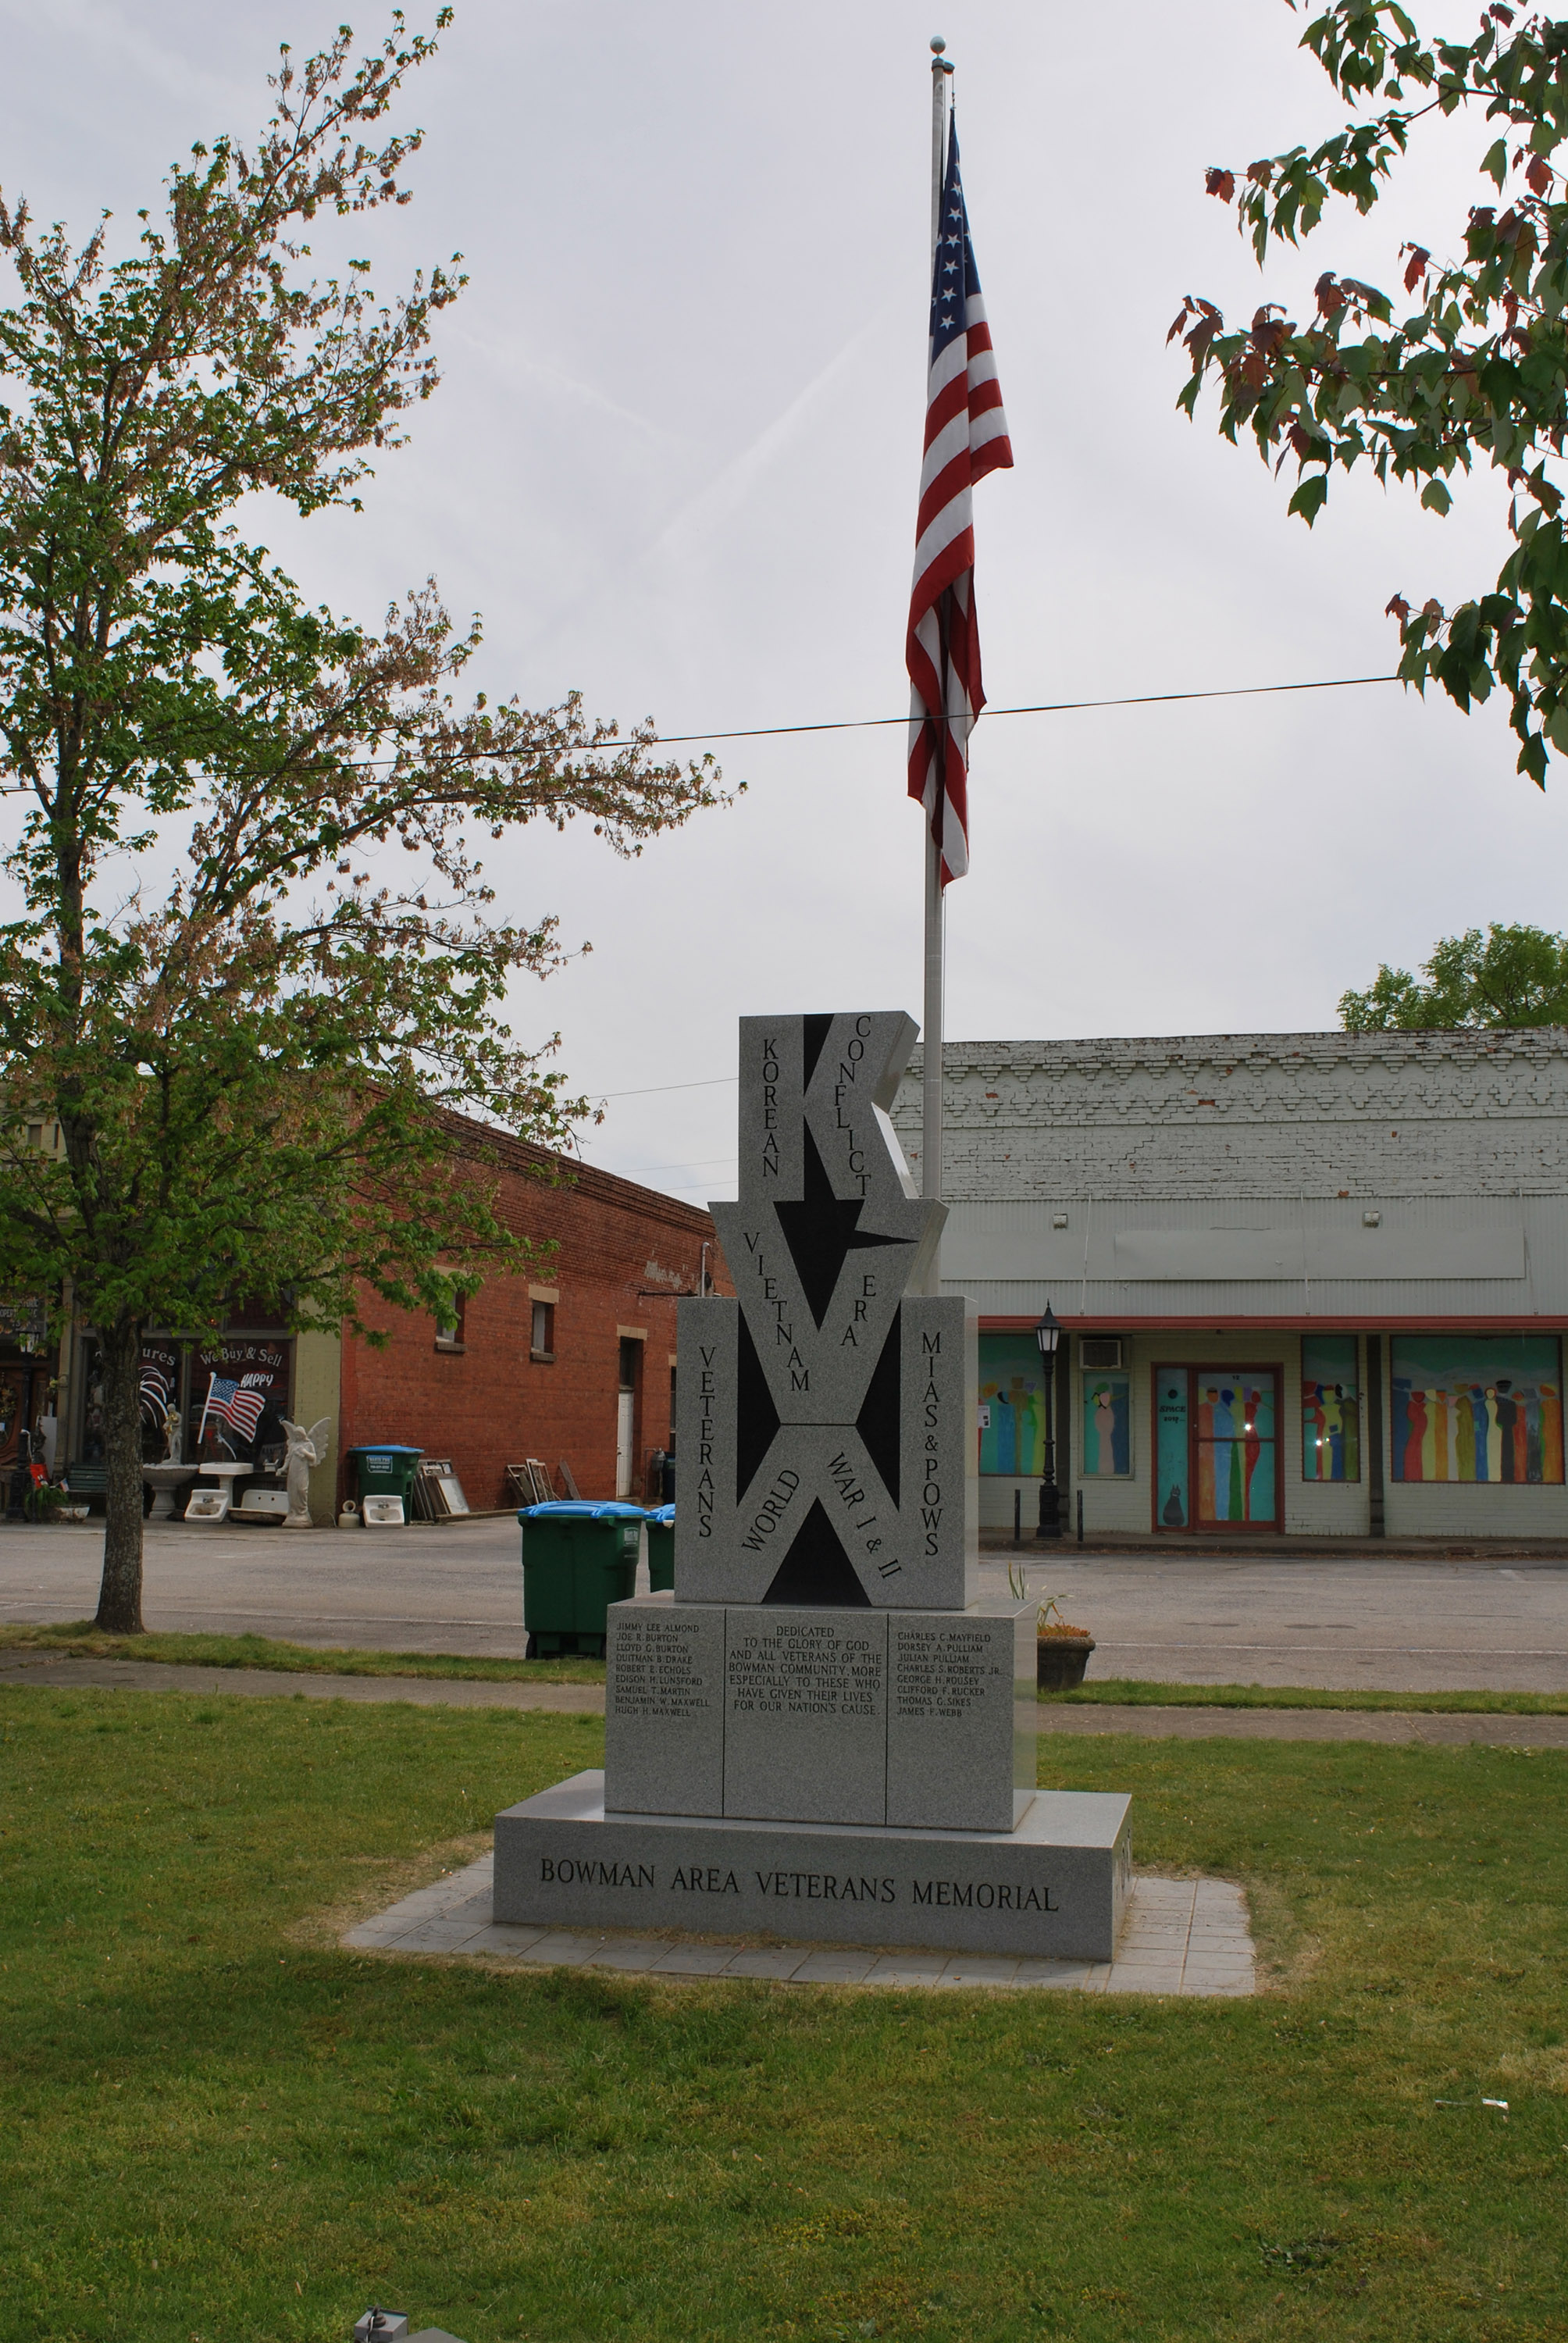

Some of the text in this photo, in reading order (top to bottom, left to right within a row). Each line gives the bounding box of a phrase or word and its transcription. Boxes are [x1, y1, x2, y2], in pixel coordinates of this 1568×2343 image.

[762, 1039, 780, 1177] KOREAN
[834, 1016, 871, 1196] CONFLICT
[743, 1232, 809, 1391] VIETNAM
[839, 1275, 876, 1346] ERA
[200, 1346, 283, 1367] We Buy & Sell
[241, 1373, 274, 1388] HAPPY
[697, 1346, 716, 1537] VETERANS
[741, 1470, 800, 1552] WORLD
[826, 1452, 902, 1579] WAR I & II
[664, 1624, 700, 1633] ALMOND
[776, 1626, 835, 1638] DEDICATED
[617, 1632, 632, 1641] JOE
[898, 1632, 935, 1641] CHARLES
[743, 1637, 869, 1651] TO THE GLORY OF GOD
[898, 1642, 932, 1652] DORSEY
[729, 1649, 882, 1664] AND ALL VETERANS OF THE
[898, 1653, 969, 1664] JULIAN PULLIAM
[615, 1664, 645, 1673] ROBERT
[729, 1662, 775, 1673] BOWMAN
[897, 1664, 935, 1673] CHARLES
[615, 1674, 645, 1683] EDISON
[730, 1675, 790, 1686] ESPECIALLY
[796, 1678, 811, 1688] TO
[816, 1678, 849, 1689] THESE
[897, 1674, 931, 1684] GEORGE
[615, 1685, 647, 1694] SAMUEL
[897, 1685, 938, 1695] CLIFFORD
[615, 1696, 655, 1704] BENJAMIN
[737, 1688, 872, 1703] HAVE GIVEN THEIR LIVES
[896, 1696, 932, 1706] THOMAS
[615, 1706, 638, 1714] HUGH
[734, 1700, 880, 1715] FOR OUR NATION'S CAUSE.
[896, 1707, 925, 1716] JAMES
[540, 1858, 1059, 1911] BOWMAN AREA VETERANS MEMORIAL
